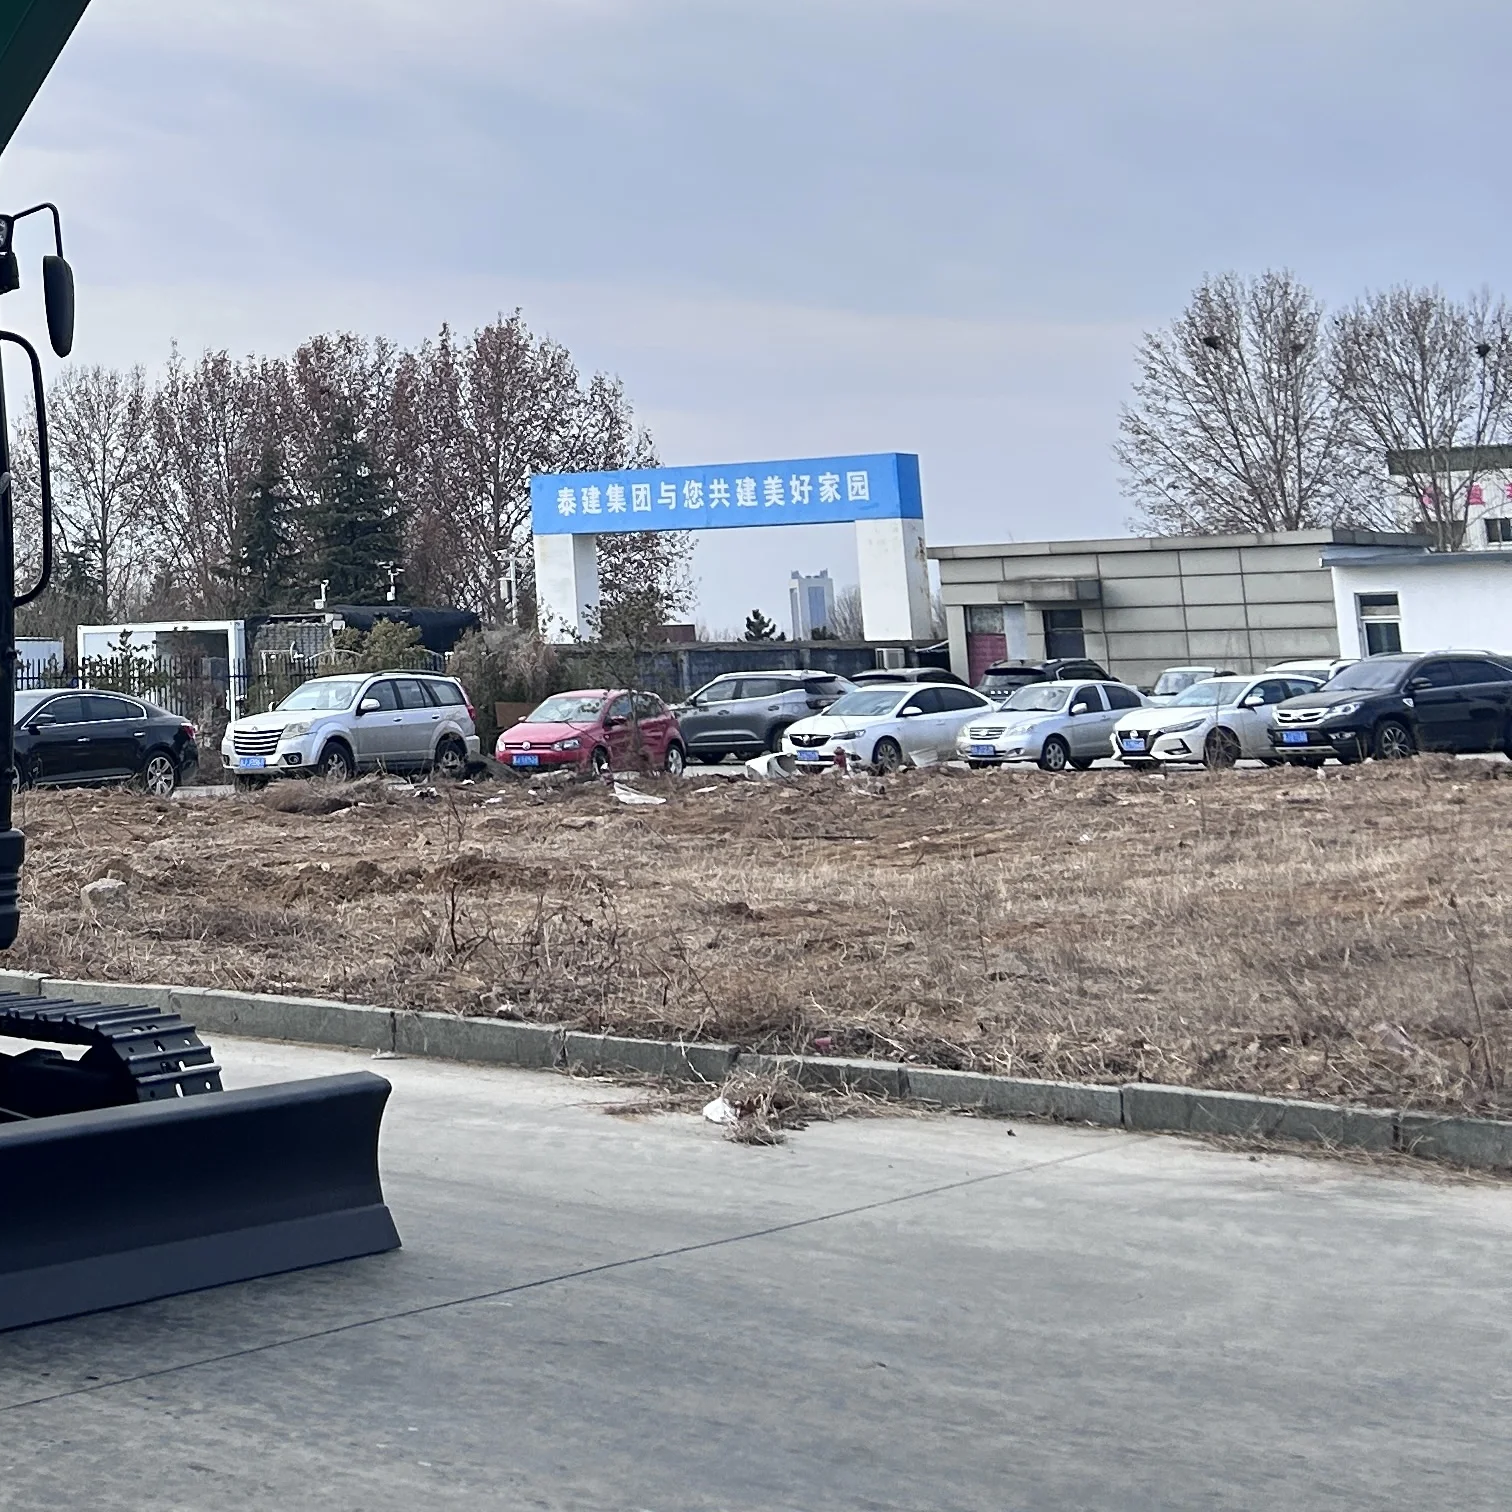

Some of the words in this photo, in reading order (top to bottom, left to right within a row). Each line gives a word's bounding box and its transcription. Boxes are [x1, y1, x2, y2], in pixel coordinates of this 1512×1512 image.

[556, 470, 870, 517] 泰建集团与您共建美好家园
